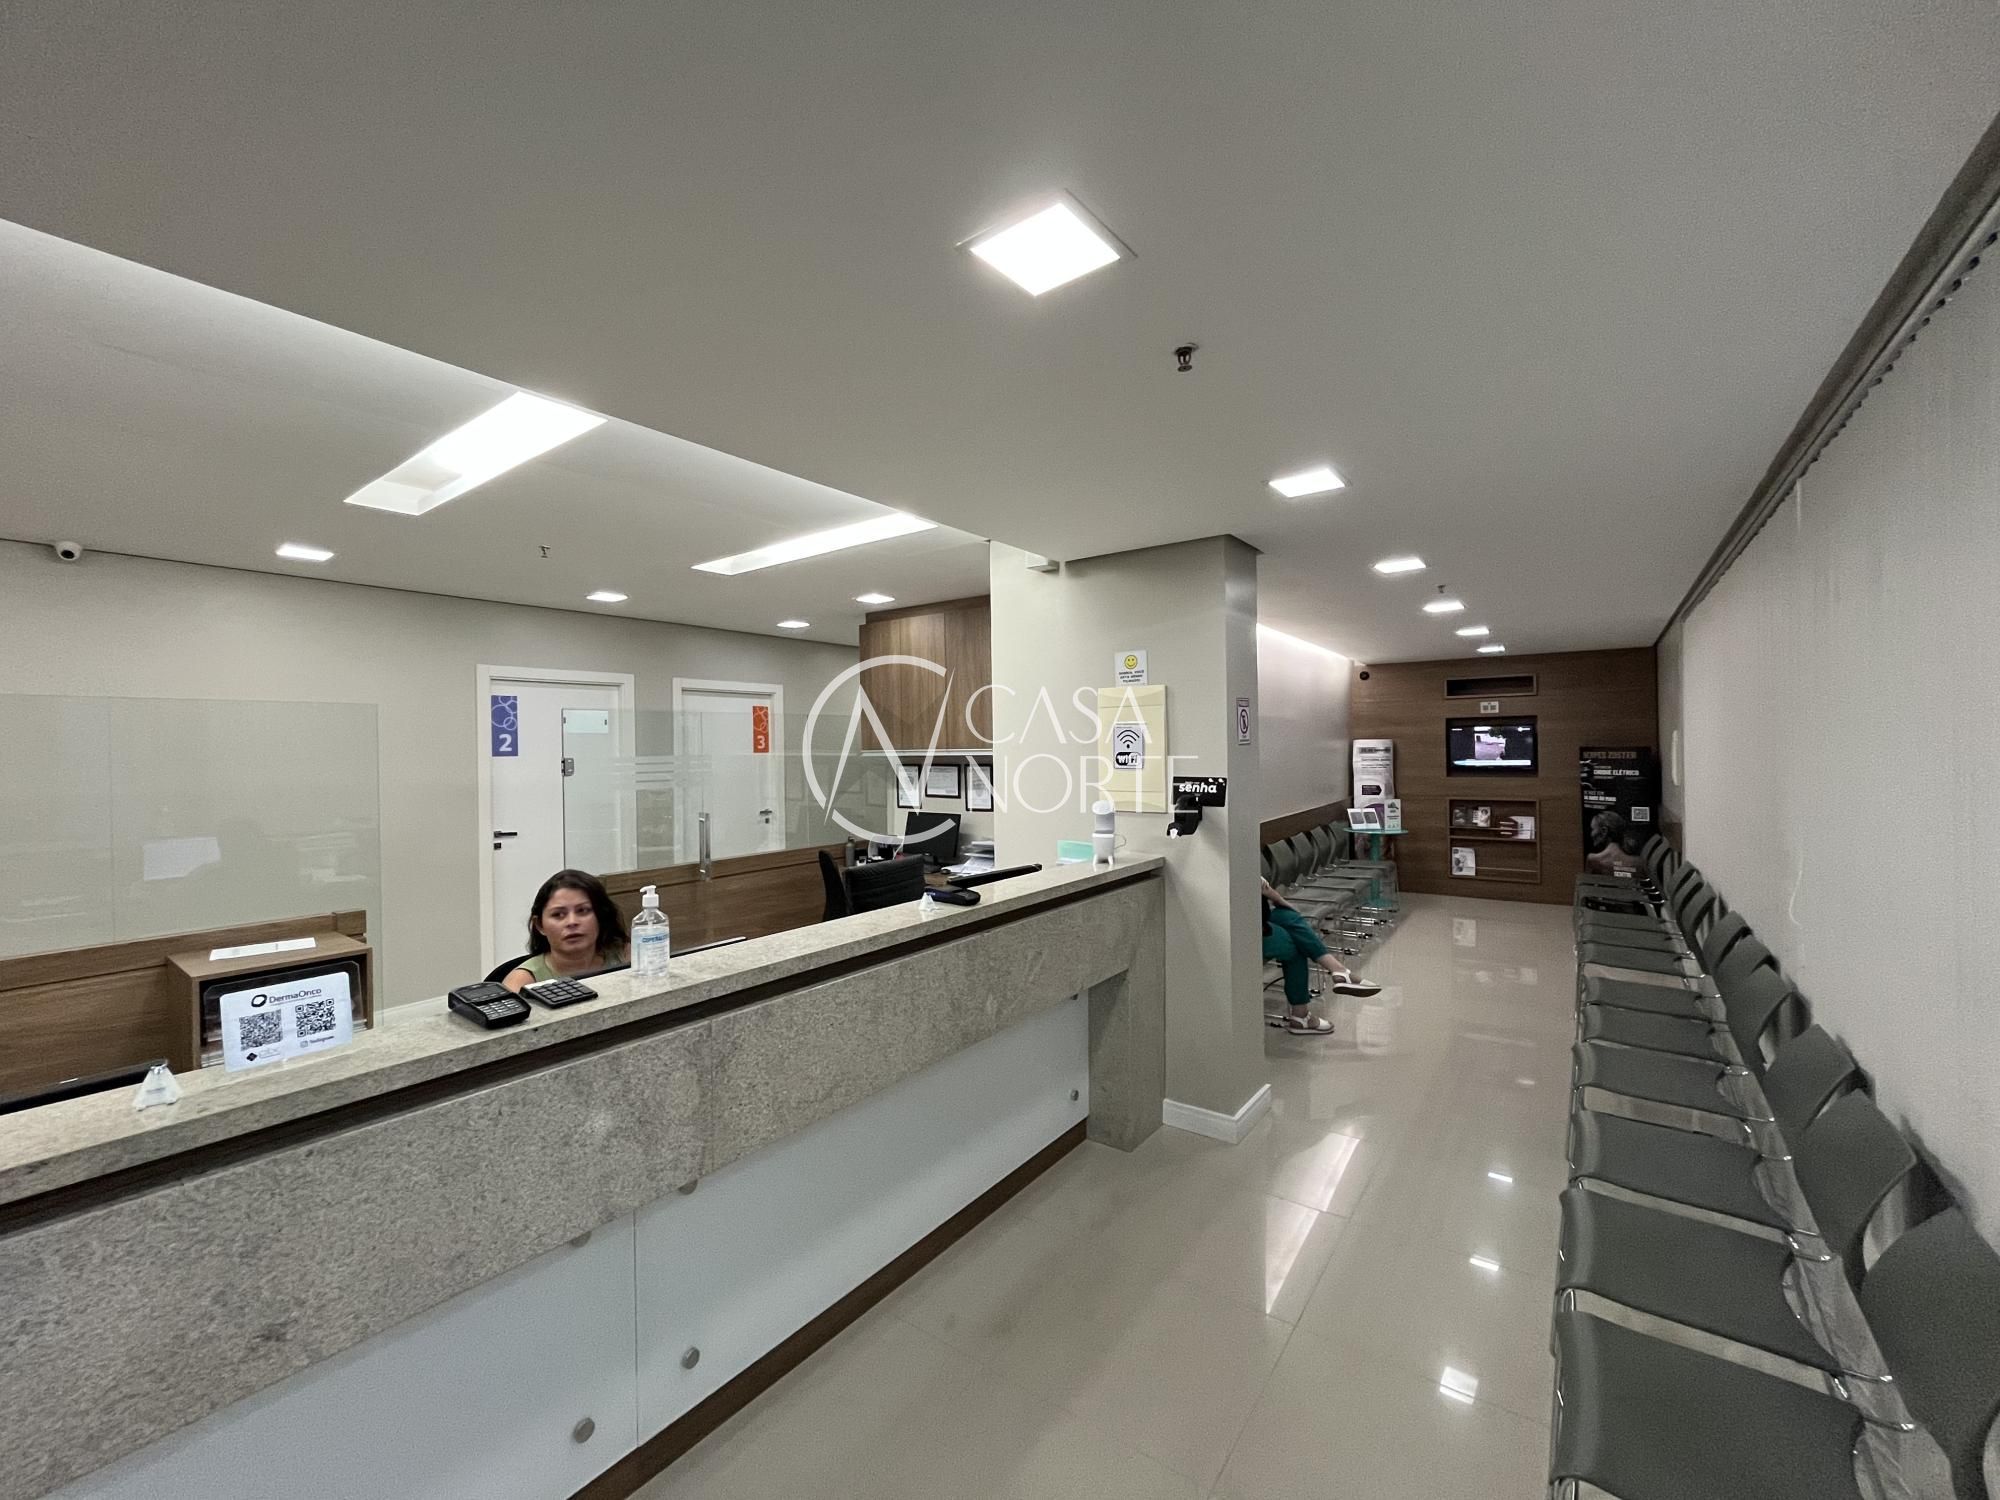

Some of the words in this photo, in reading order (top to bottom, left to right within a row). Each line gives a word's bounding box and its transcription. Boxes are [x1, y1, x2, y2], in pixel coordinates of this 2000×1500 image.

[499, 733, 513, 751] 2
[757, 735, 766, 749] 3
[1178, 781, 1218, 793] senha
[269, 988, 322, 1003] DermaOnco
